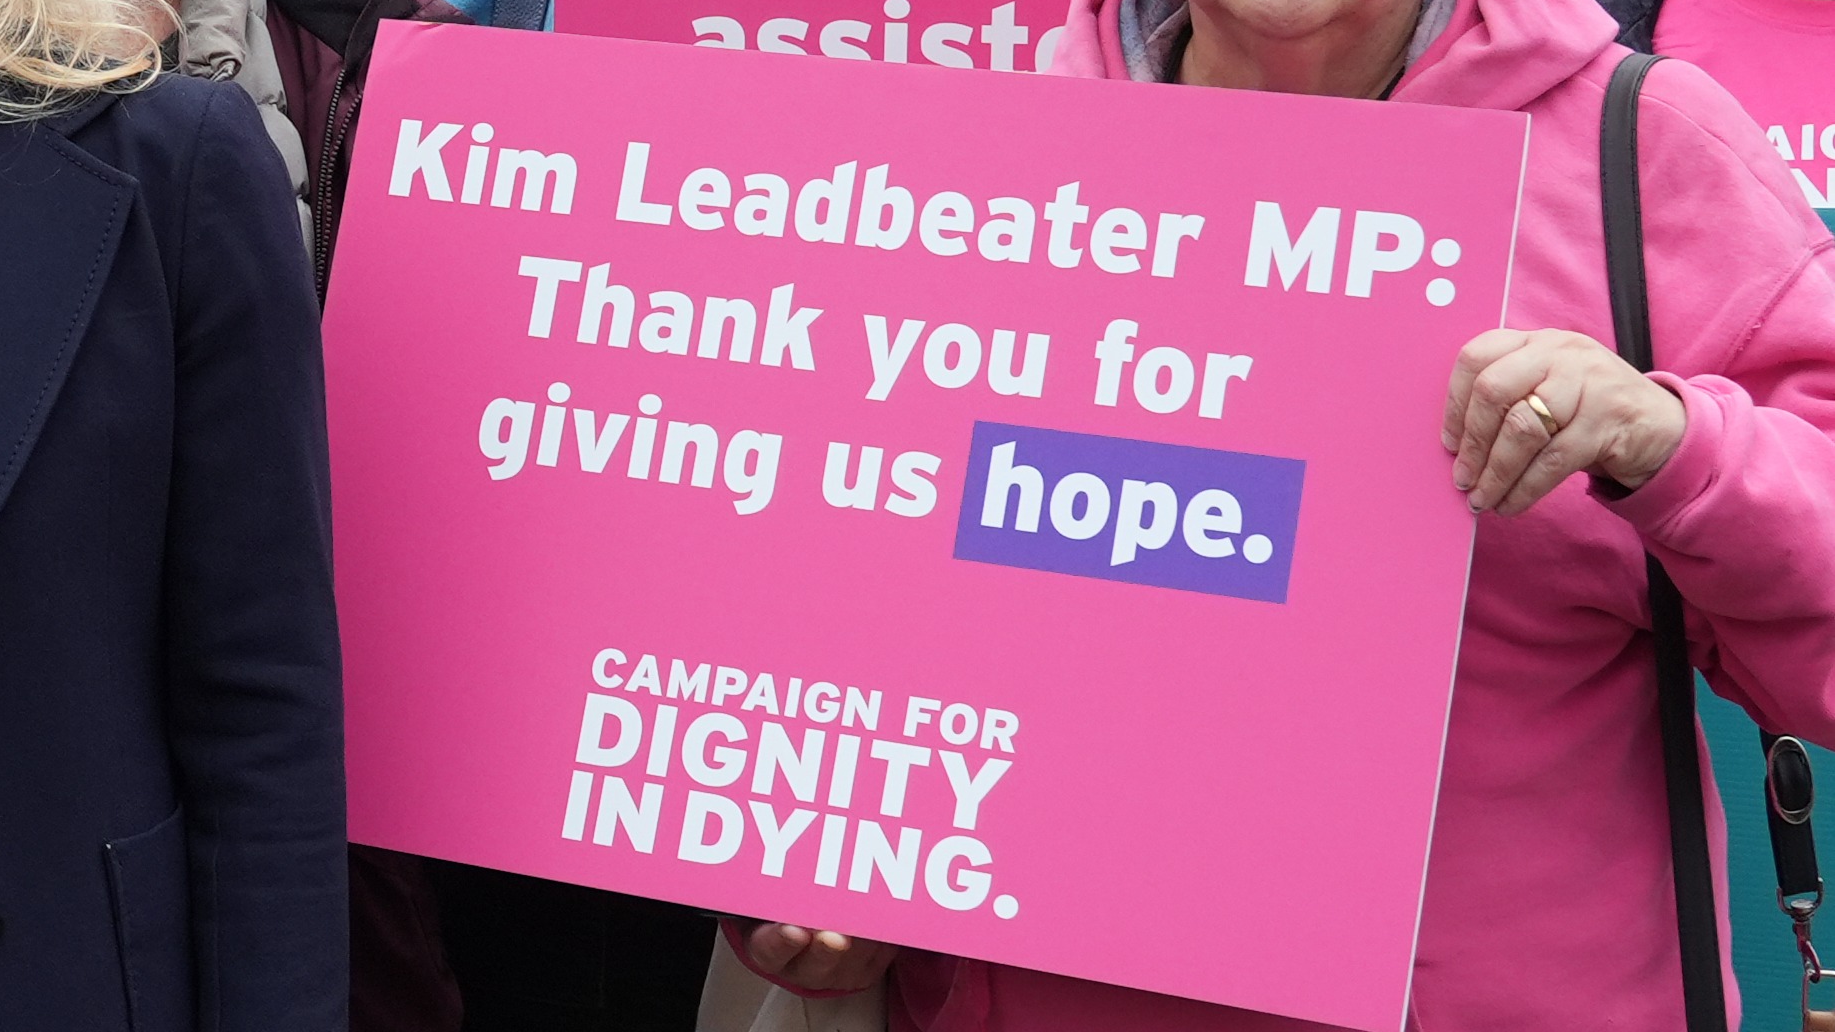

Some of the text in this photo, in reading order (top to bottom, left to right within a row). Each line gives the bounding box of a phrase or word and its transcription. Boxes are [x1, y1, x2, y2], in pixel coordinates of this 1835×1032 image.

[388, 118, 1463, 307] Kim Leadbeater MP:
[517, 254, 1254, 420] Thank you for
[478, 381, 1275, 567] giving us hope.
[574, 692, 1014, 832] DIGNITY
[590, 648, 1020, 755] CAMPAIGN FOR
[561, 769, 1020, 922] IN DYING.
